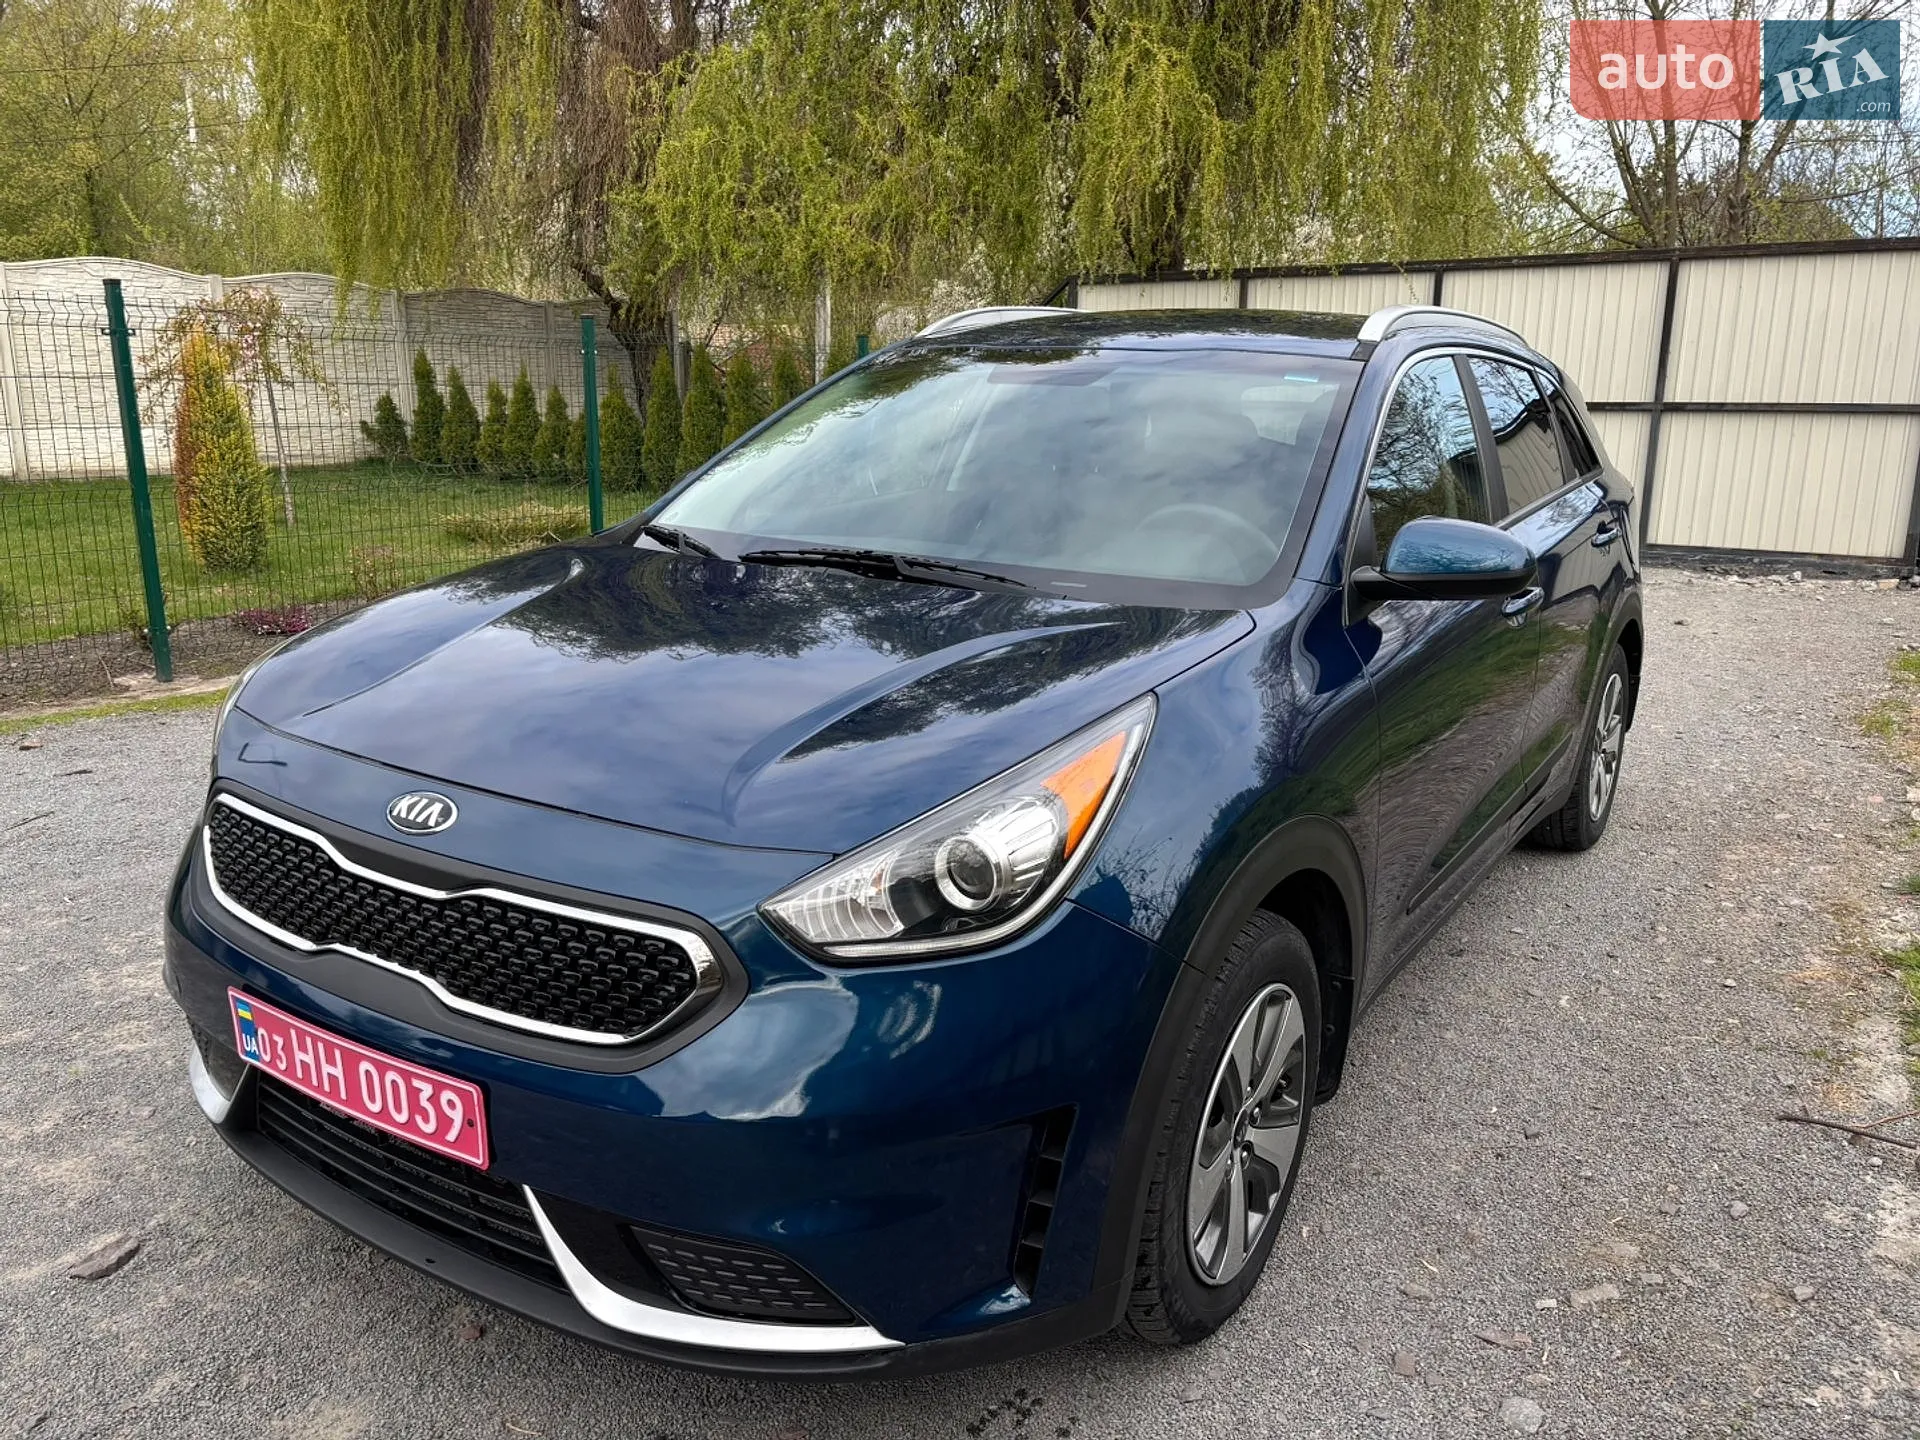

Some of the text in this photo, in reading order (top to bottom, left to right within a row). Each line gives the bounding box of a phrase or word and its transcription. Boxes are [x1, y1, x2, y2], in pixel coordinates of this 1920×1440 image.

[392, 795, 444, 828] KIA
[241, 1032, 259, 1056] UA
[358, 1060, 464, 1143] 0039
